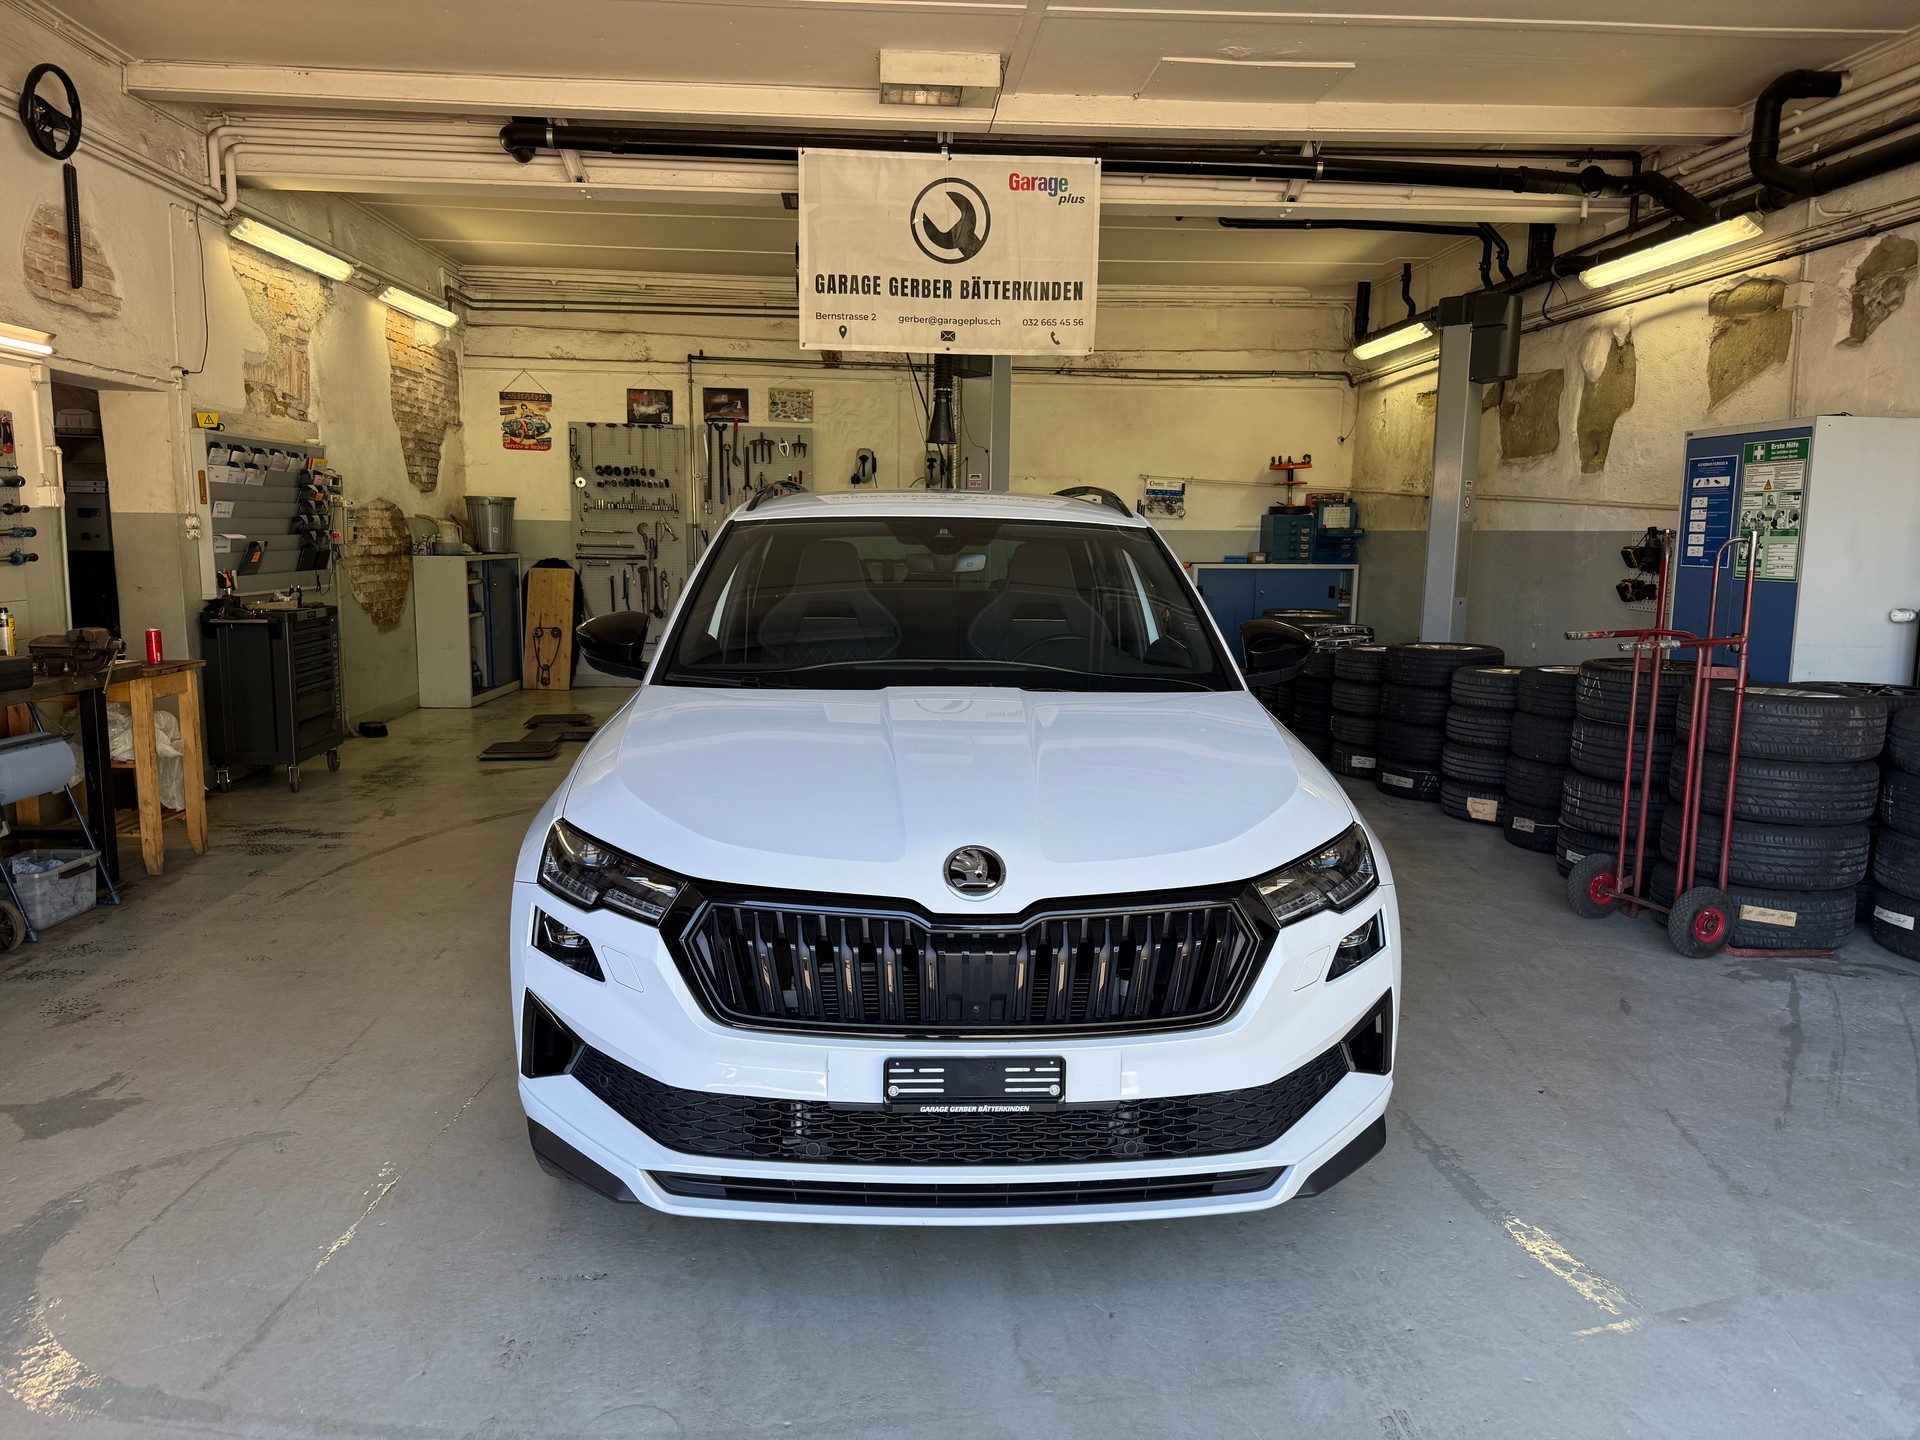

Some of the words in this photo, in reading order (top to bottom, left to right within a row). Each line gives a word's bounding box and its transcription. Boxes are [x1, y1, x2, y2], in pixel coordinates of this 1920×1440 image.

[1009, 173, 1068, 197] Garage
[1058, 193, 1085, 205] plus
[815, 274, 881, 295] GARAGE
[889, 278, 952, 299] GERBER
[960, 276, 1083, 301] BÄTTERKINDEN
[815, 312, 869, 321] Bernstrasse
[871, 313, 877, 321] 2
[898, 314, 1001, 326] gerber@garageplus.ch
[1022, 318, 1039, 326] 032
[1041, 318, 1057, 326] 665
[1059, 318, 1071, 326] 45
[1072, 318, 1084, 326] 56
